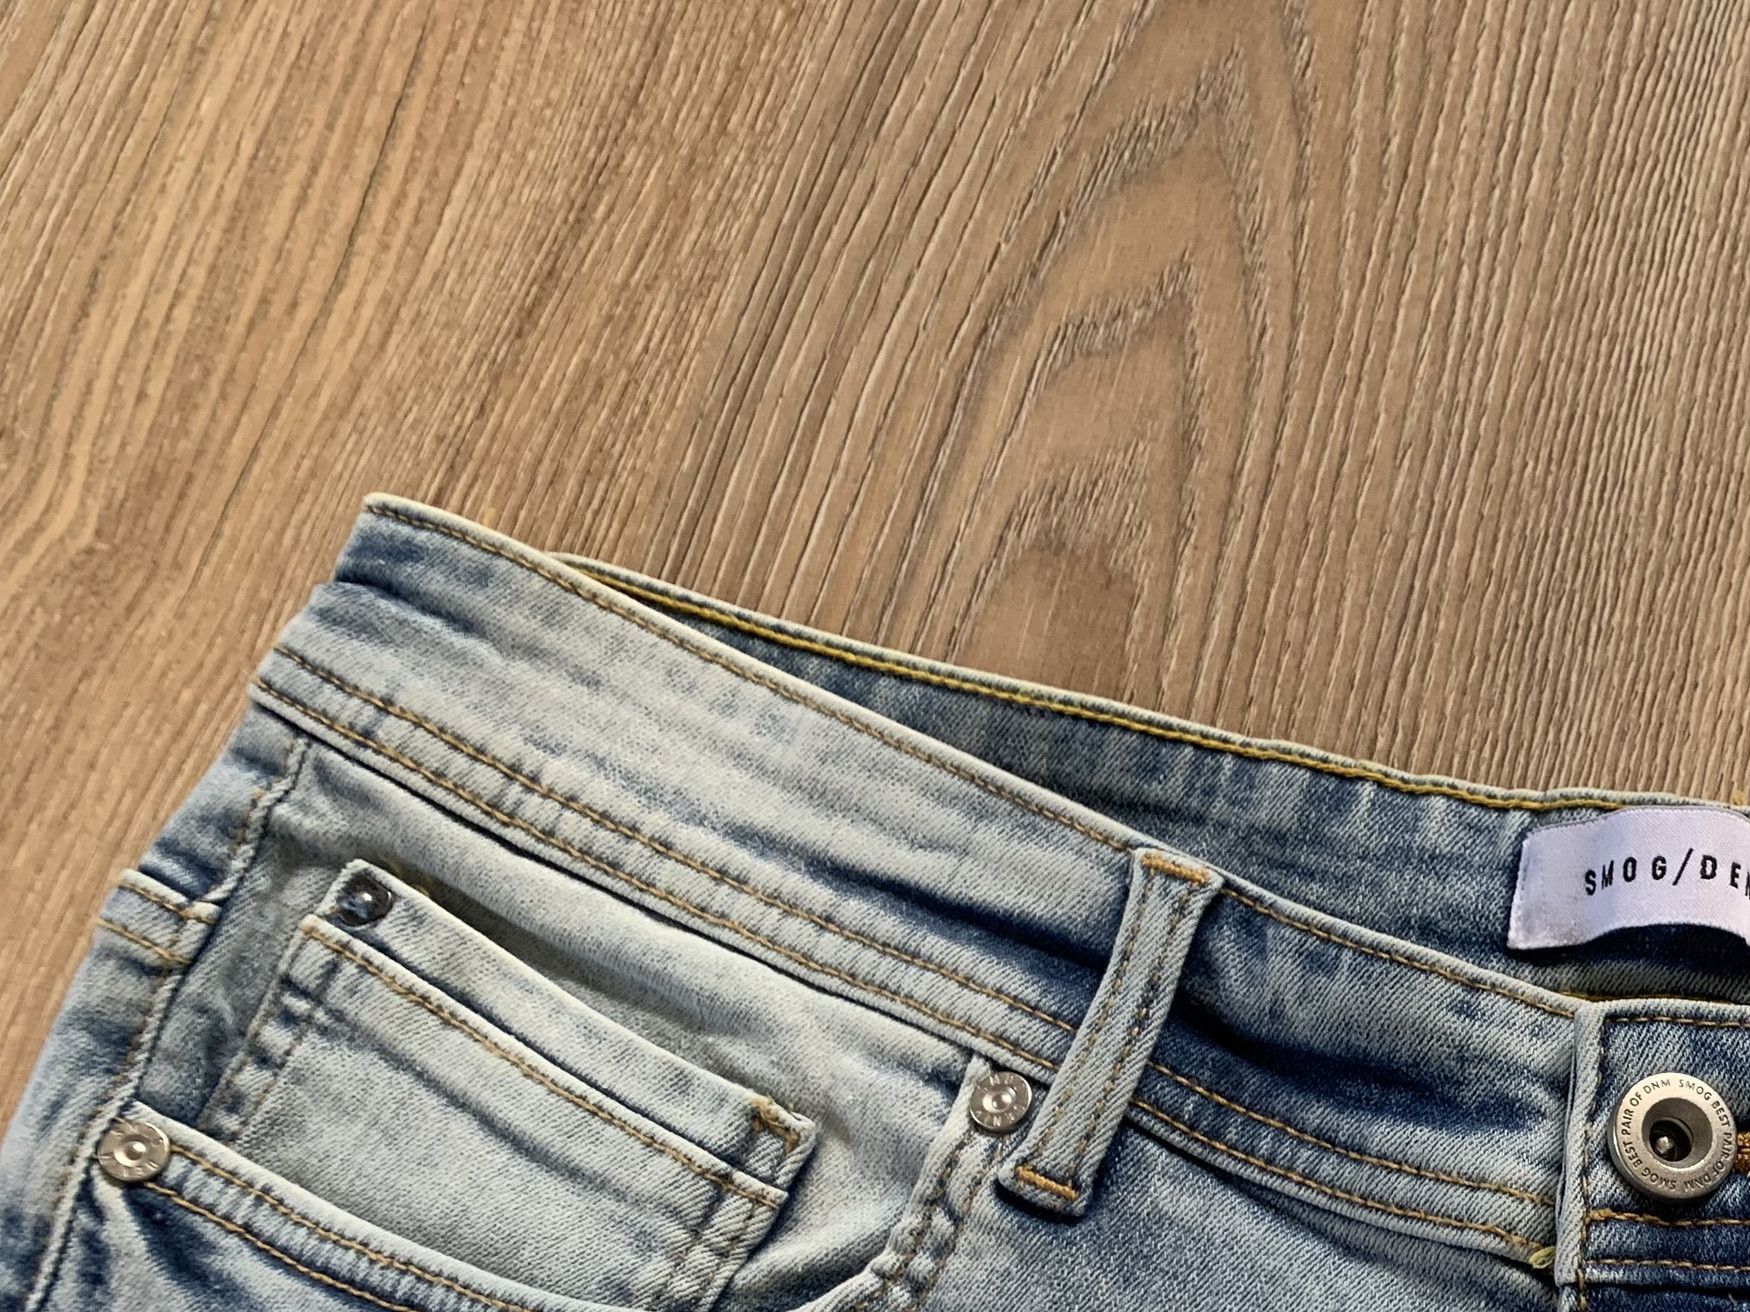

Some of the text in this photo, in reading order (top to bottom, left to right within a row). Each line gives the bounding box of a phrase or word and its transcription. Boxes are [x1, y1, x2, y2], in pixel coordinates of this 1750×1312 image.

[1621, 1078, 1677, 1191] SMOG BEST PAIR OF DNM
[1678, 1079, 1713, 1101] SMOG
[1711, 1100, 1731, 1128] BEST
